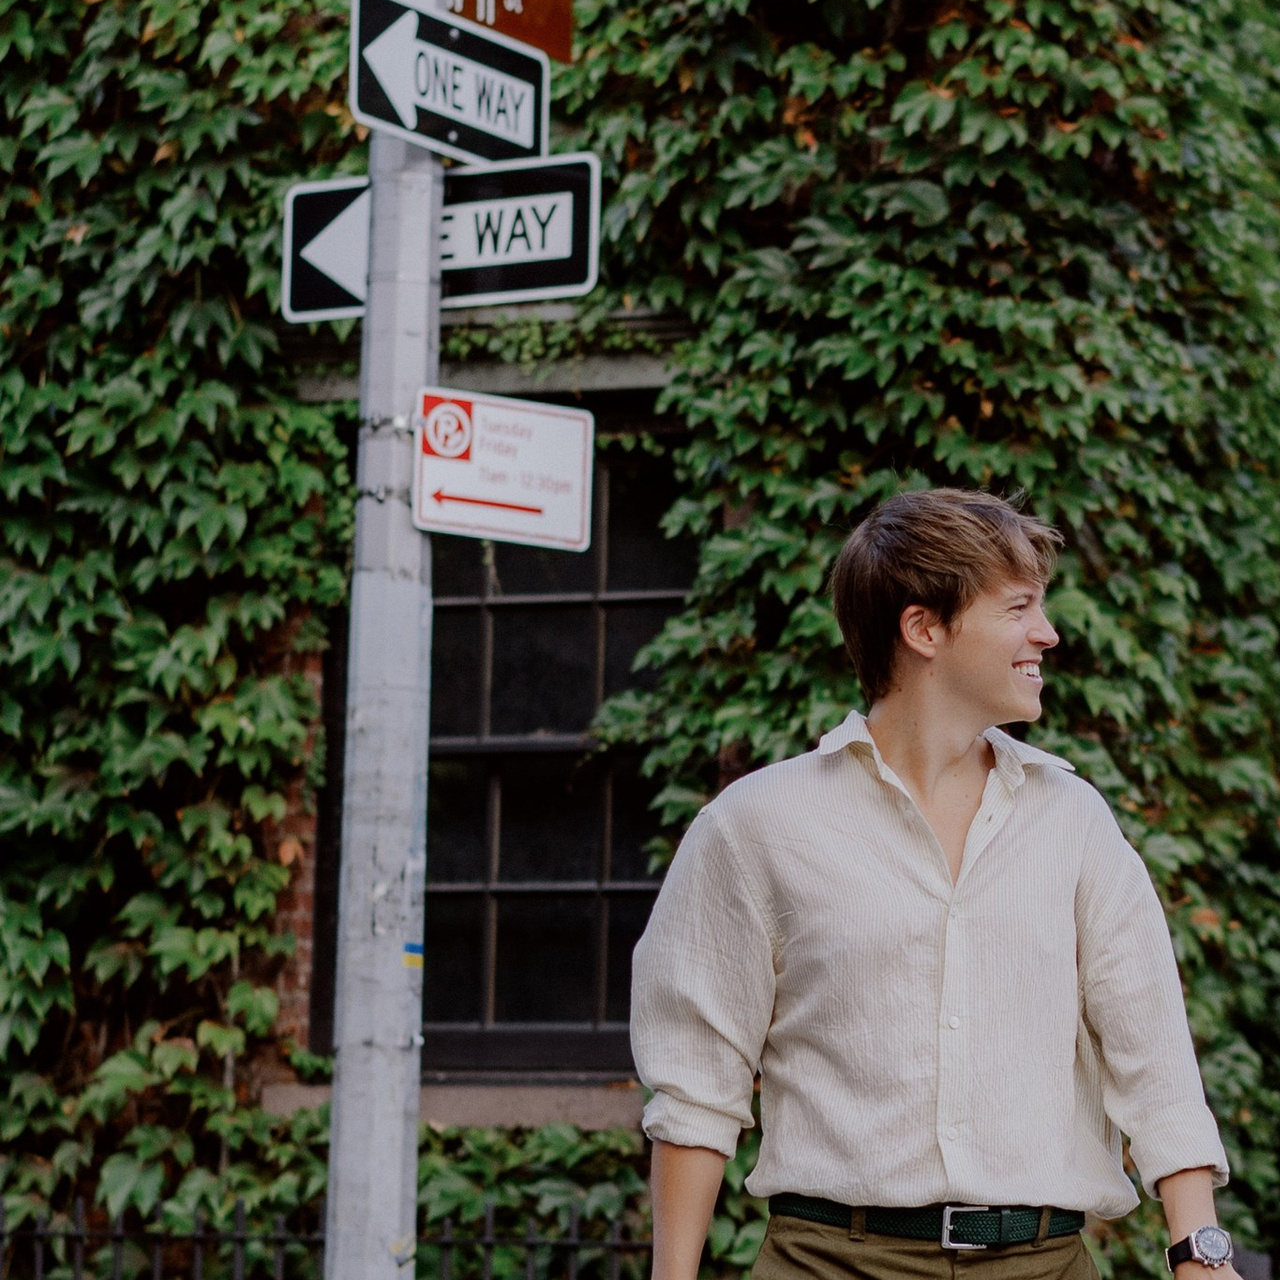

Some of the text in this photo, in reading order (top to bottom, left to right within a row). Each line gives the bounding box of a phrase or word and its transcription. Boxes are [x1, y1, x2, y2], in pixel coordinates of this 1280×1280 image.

[415, 51, 525, 133] ONE WAY
[475, 204, 557, 255] WAY
